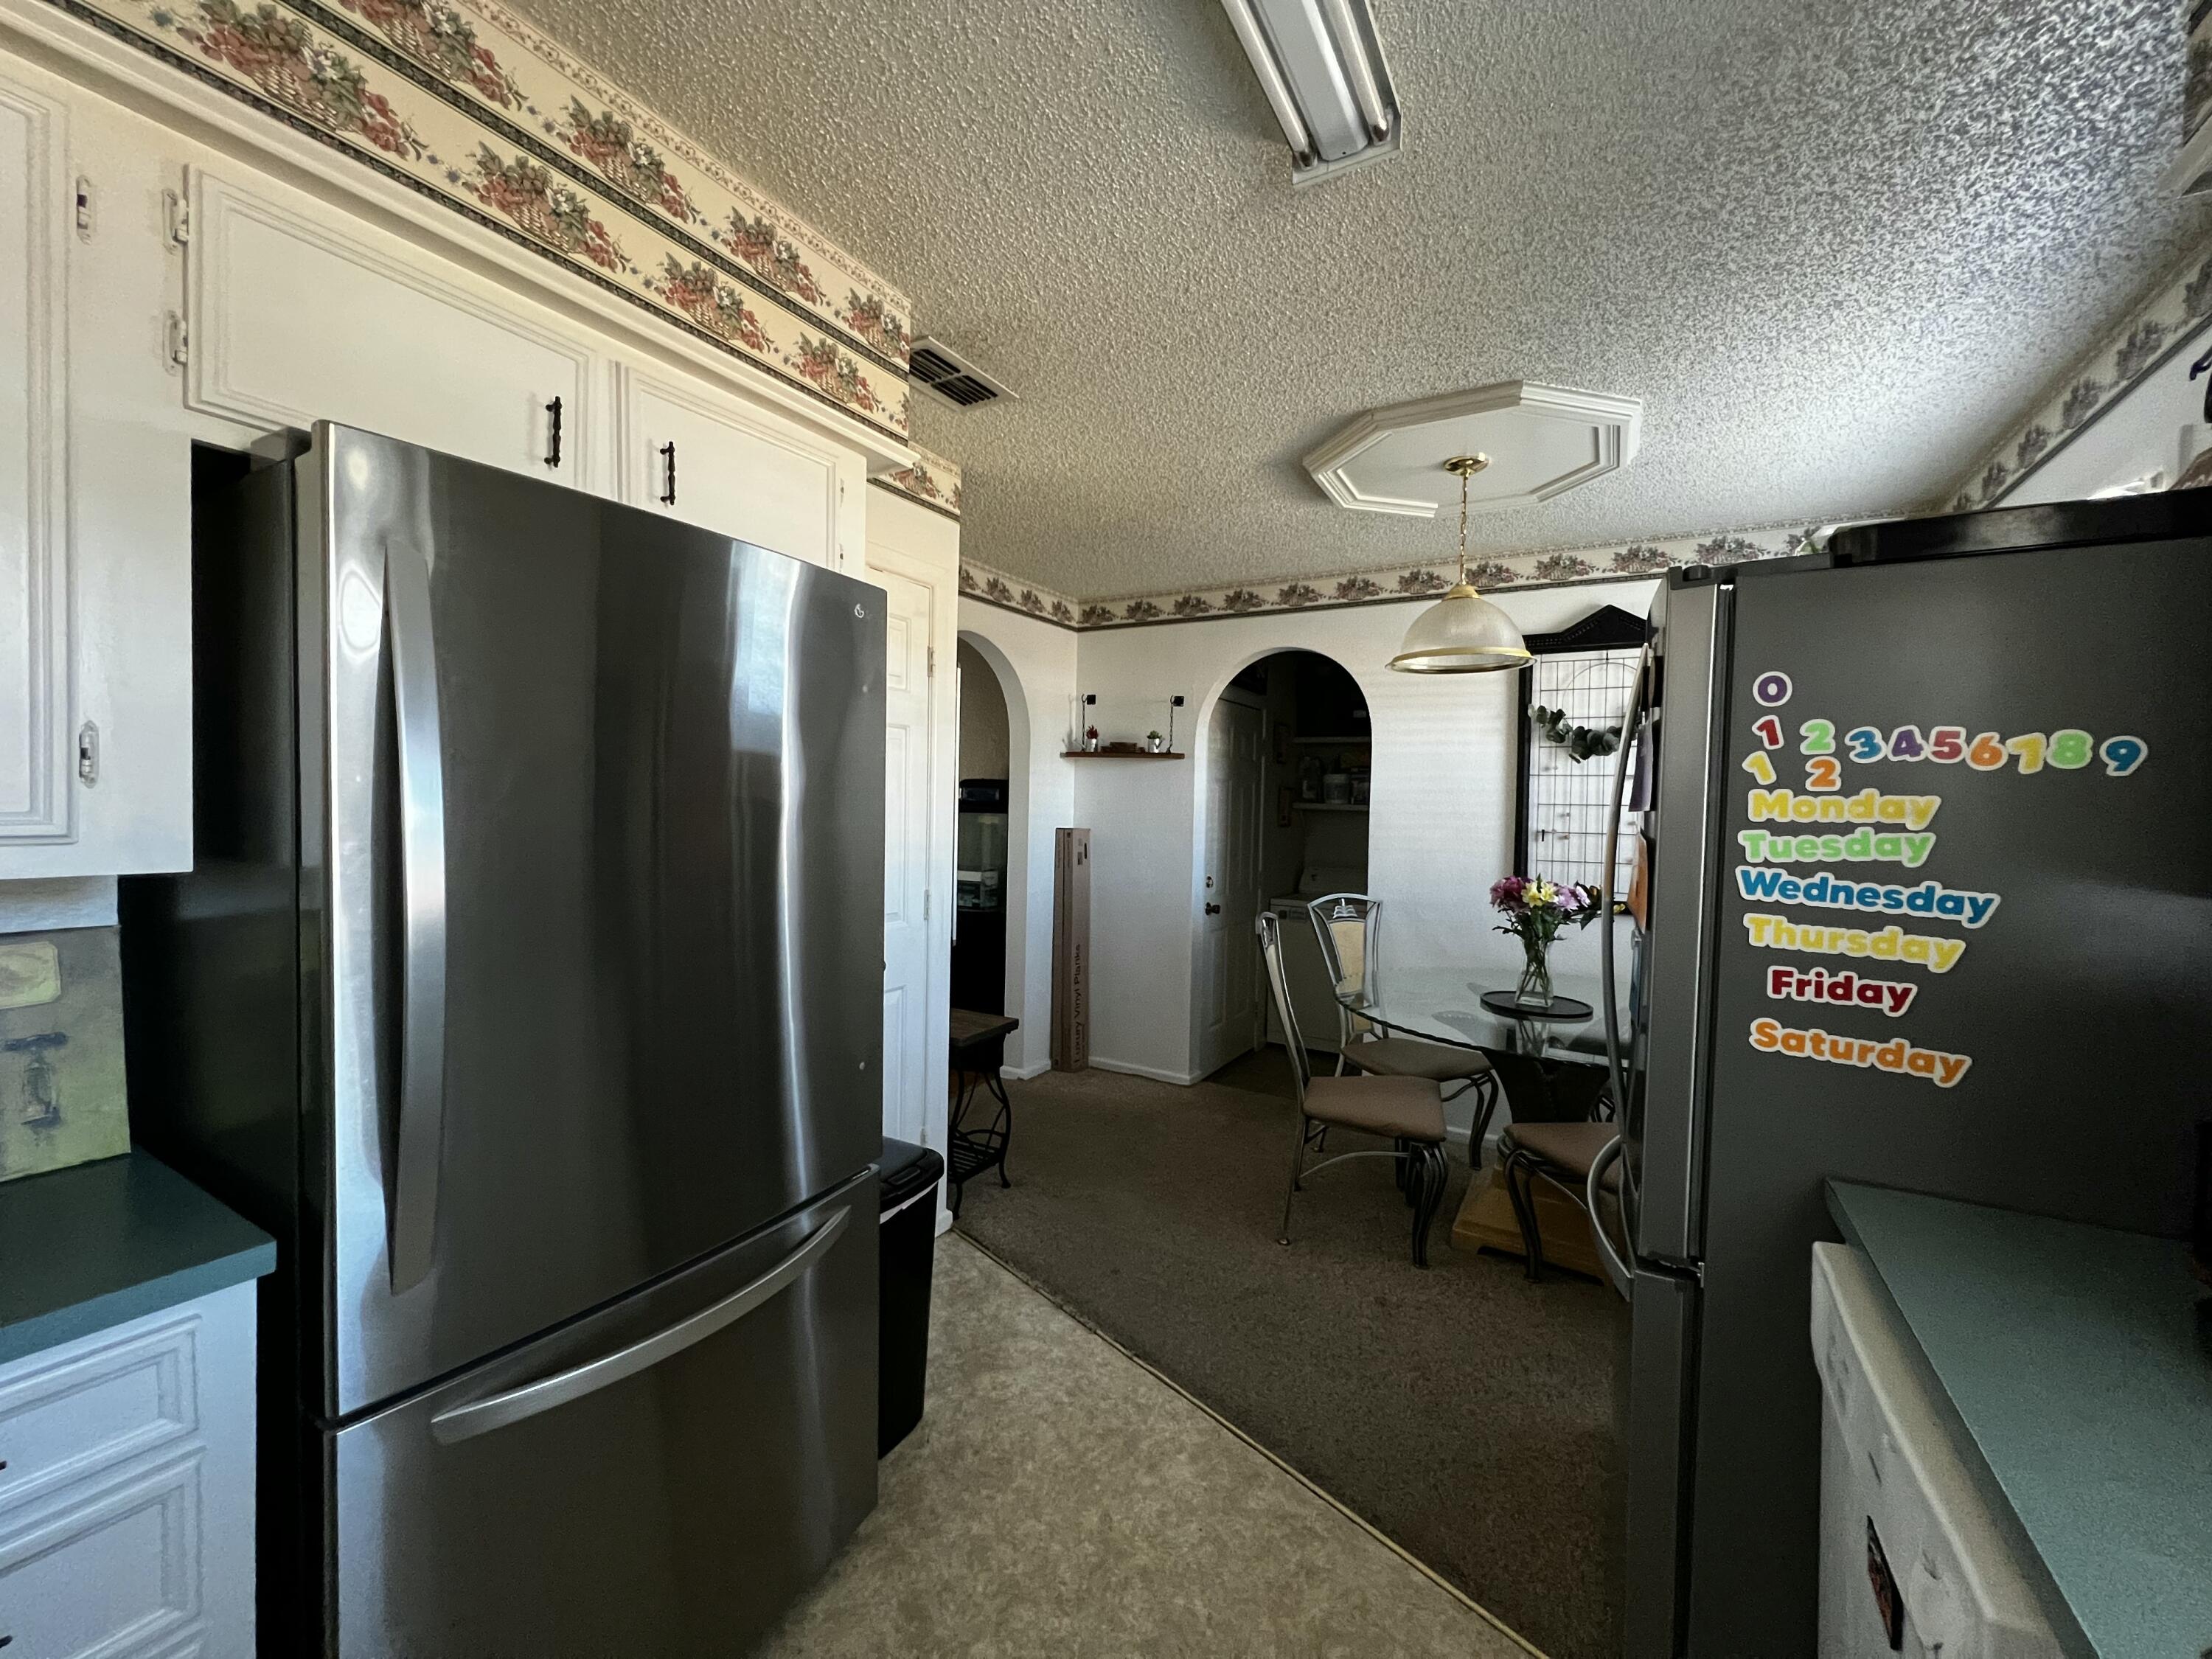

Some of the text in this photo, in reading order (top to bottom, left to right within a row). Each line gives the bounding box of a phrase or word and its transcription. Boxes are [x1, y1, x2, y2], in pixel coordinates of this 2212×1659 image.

[1756, 718, 1781, 747] 1
[1804, 722, 1832, 751] 2
[2105, 739, 2142, 773] 9
[1745, 754, 1838, 788] 1 2
[1751, 791, 1938, 827] Monday
[1742, 830, 1933, 865] Tuesday
[1741, 869, 1997, 924] Wednesday
[1747, 916, 1964, 970] Thursday
[1074, 988, 1082, 1018] Vinyl
[1771, 970, 1913, 1013] Friday
[1074, 1021, 1082, 1062] Luxury
[1753, 1021, 1969, 1085] Saturday
